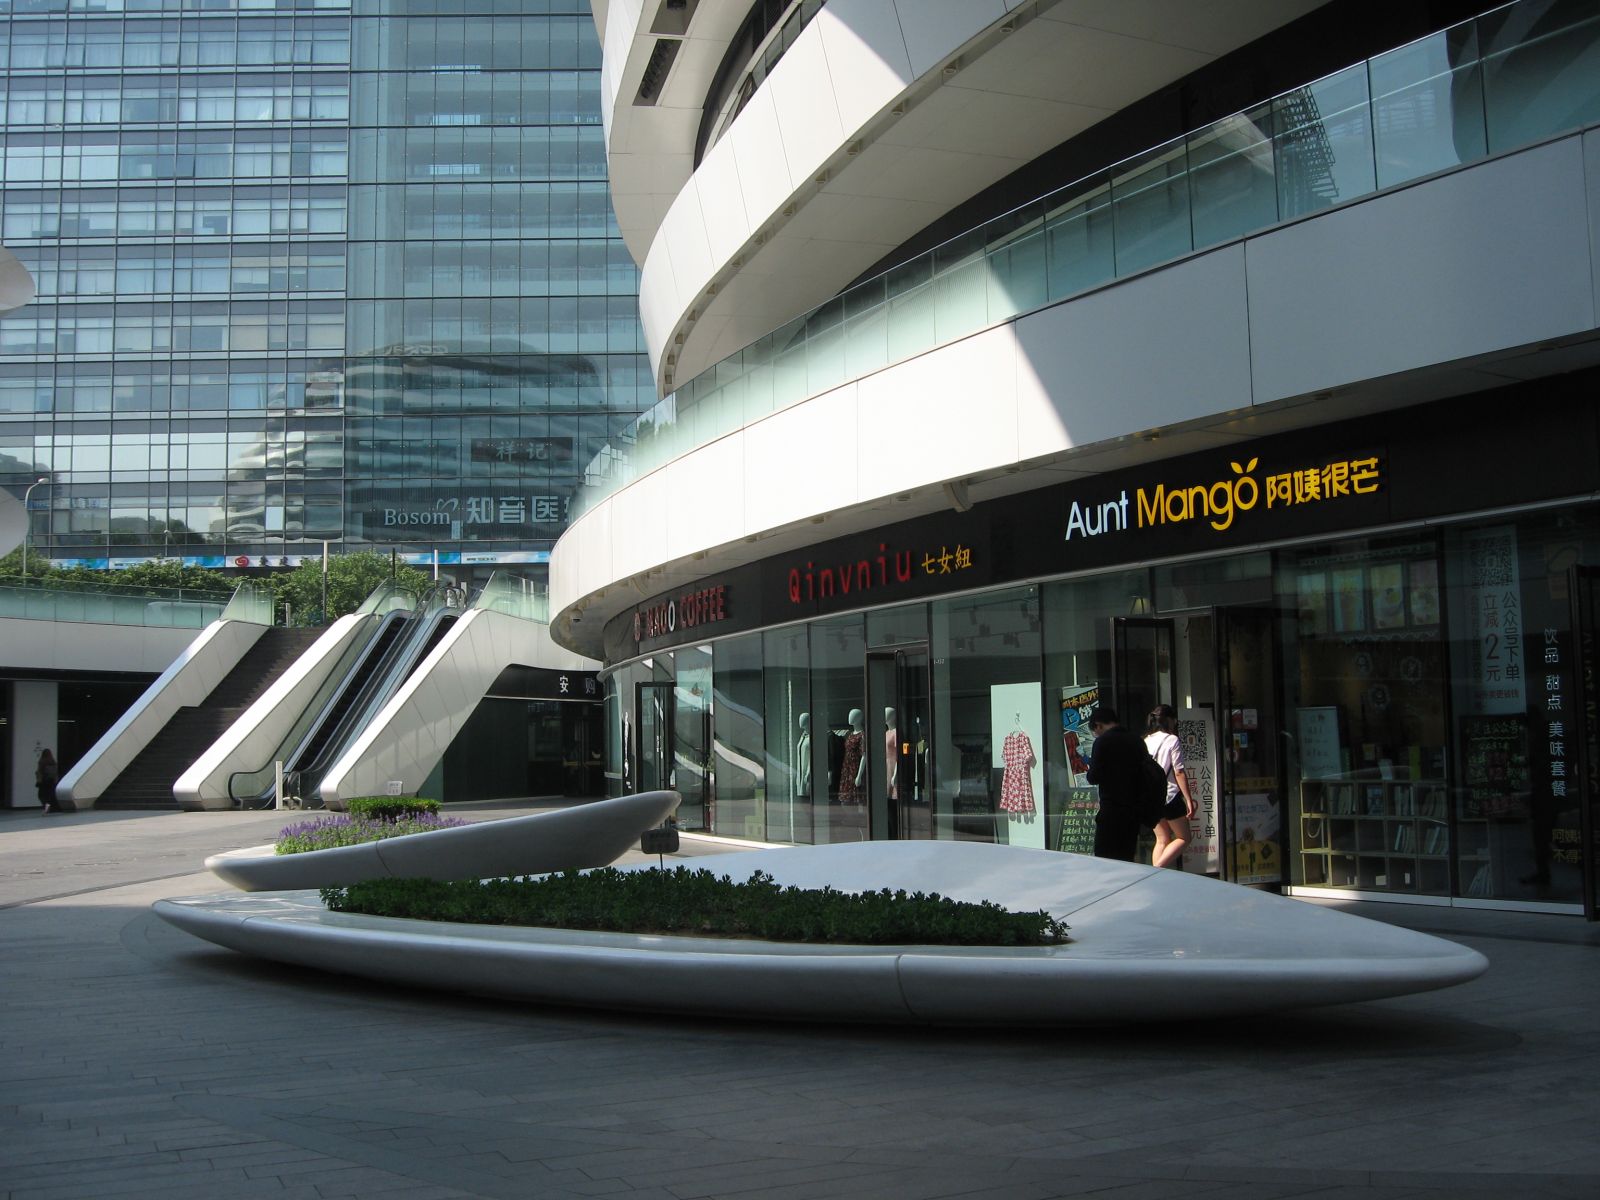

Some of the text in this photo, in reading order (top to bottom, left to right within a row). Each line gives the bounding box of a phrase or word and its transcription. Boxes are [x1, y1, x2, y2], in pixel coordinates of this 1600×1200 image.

[1065, 474, 1259, 541] Aunt Mango
[1266, 457, 1379, 509] 阿姨很芒
[384, 508, 450, 526] Bosom
[680, 585, 727, 629] COFFEE
[788, 543, 912, 604] Qinvniu
[1483, 593, 1501, 682] 立减2元
[1502, 591, 1520, 682] 公众号下单
[1544, 627, 1568, 799] 饮品 甜点 美味套餐
[1200, 765, 1216, 839] 公众号下单
